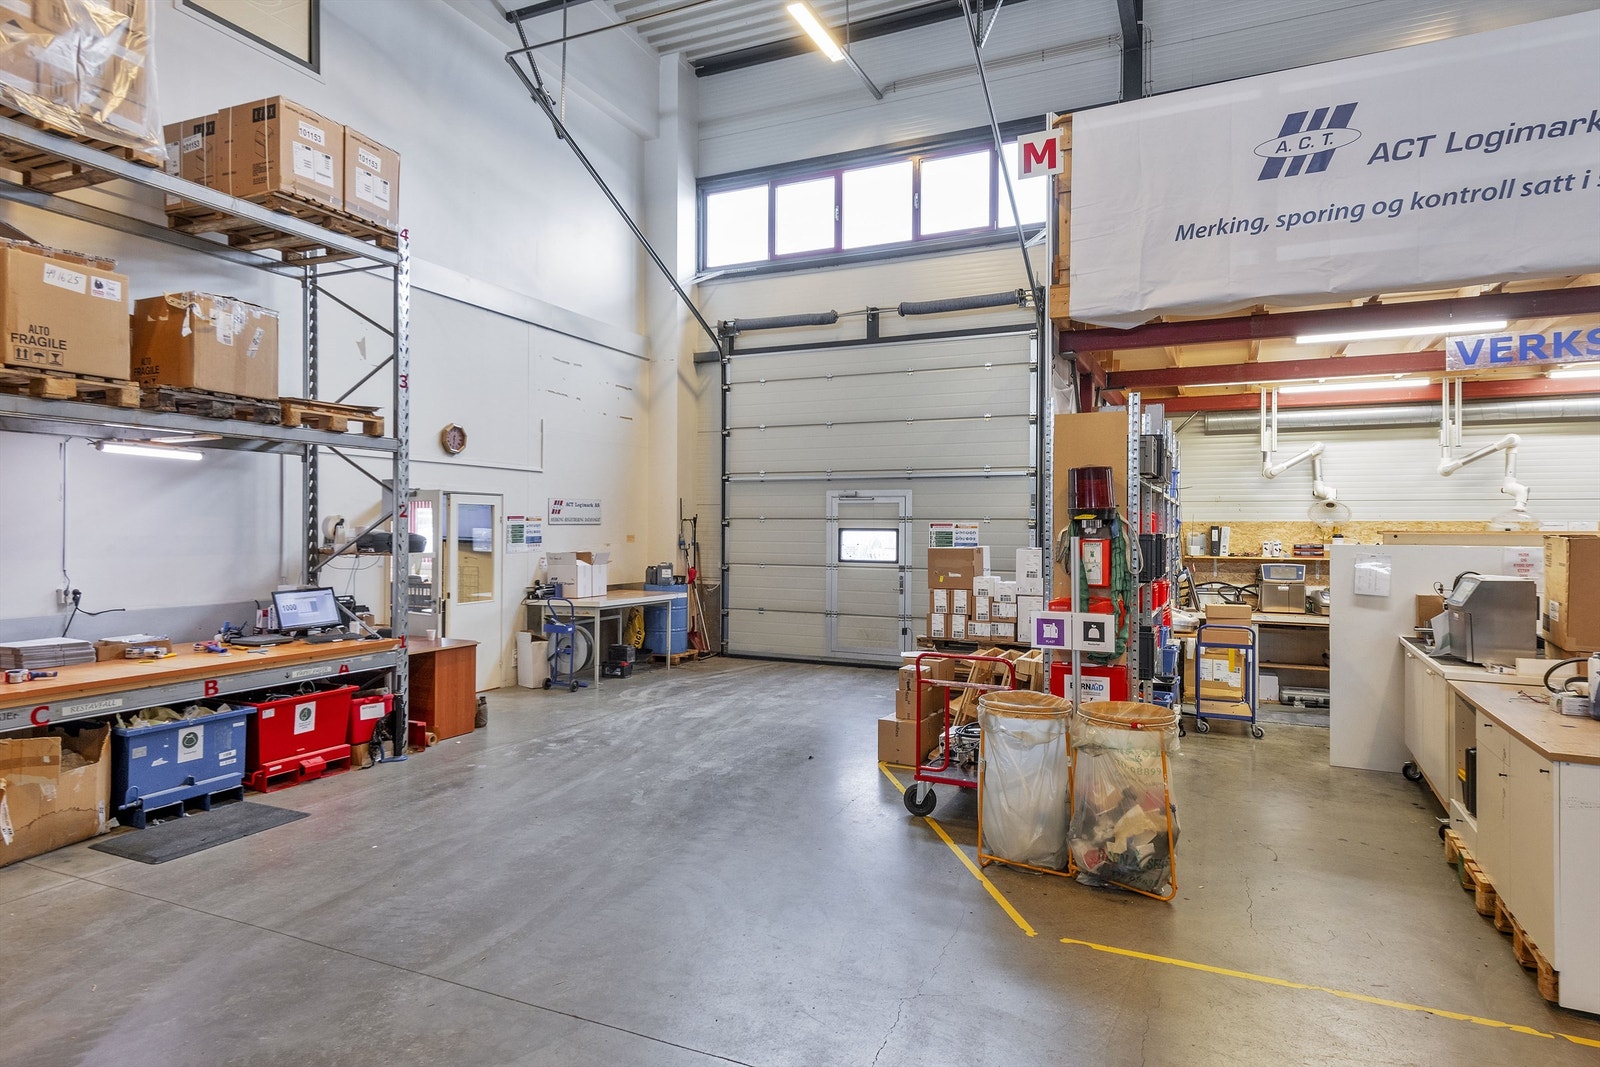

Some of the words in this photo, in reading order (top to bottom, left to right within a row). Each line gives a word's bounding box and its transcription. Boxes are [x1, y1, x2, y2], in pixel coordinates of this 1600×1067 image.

[299, 127, 321, 143] 101153
[1366, 134, 1437, 165] ACT
[1445, 109, 1600, 154] Logimark
[1023, 137, 1057, 174] M
[1174, 216, 1270, 242] Merking,
[1275, 203, 1365, 231] sporing
[1371, 198, 1404, 218] og
[1409, 178, 1517, 211] kontroll
[1520, 173, 1577, 198] satt
[1581, 169, 1592, 190] i
[400, 228, 409, 242] 4
[28, 324, 50, 336] ALTO
[10, 332, 67, 351] FRAGILE
[1454, 327, 1600, 366] VERKS
[133, 365, 160, 376] FRAGILE
[399, 374, 408, 389] 3
[399, 504, 408, 518] 2
[399, 635, 407, 649] 1
[338, 663, 350, 675] A
[204, 679, 219, 698] B
[1069, 681, 1105, 692] RNAID
[30, 705, 50, 727] C
